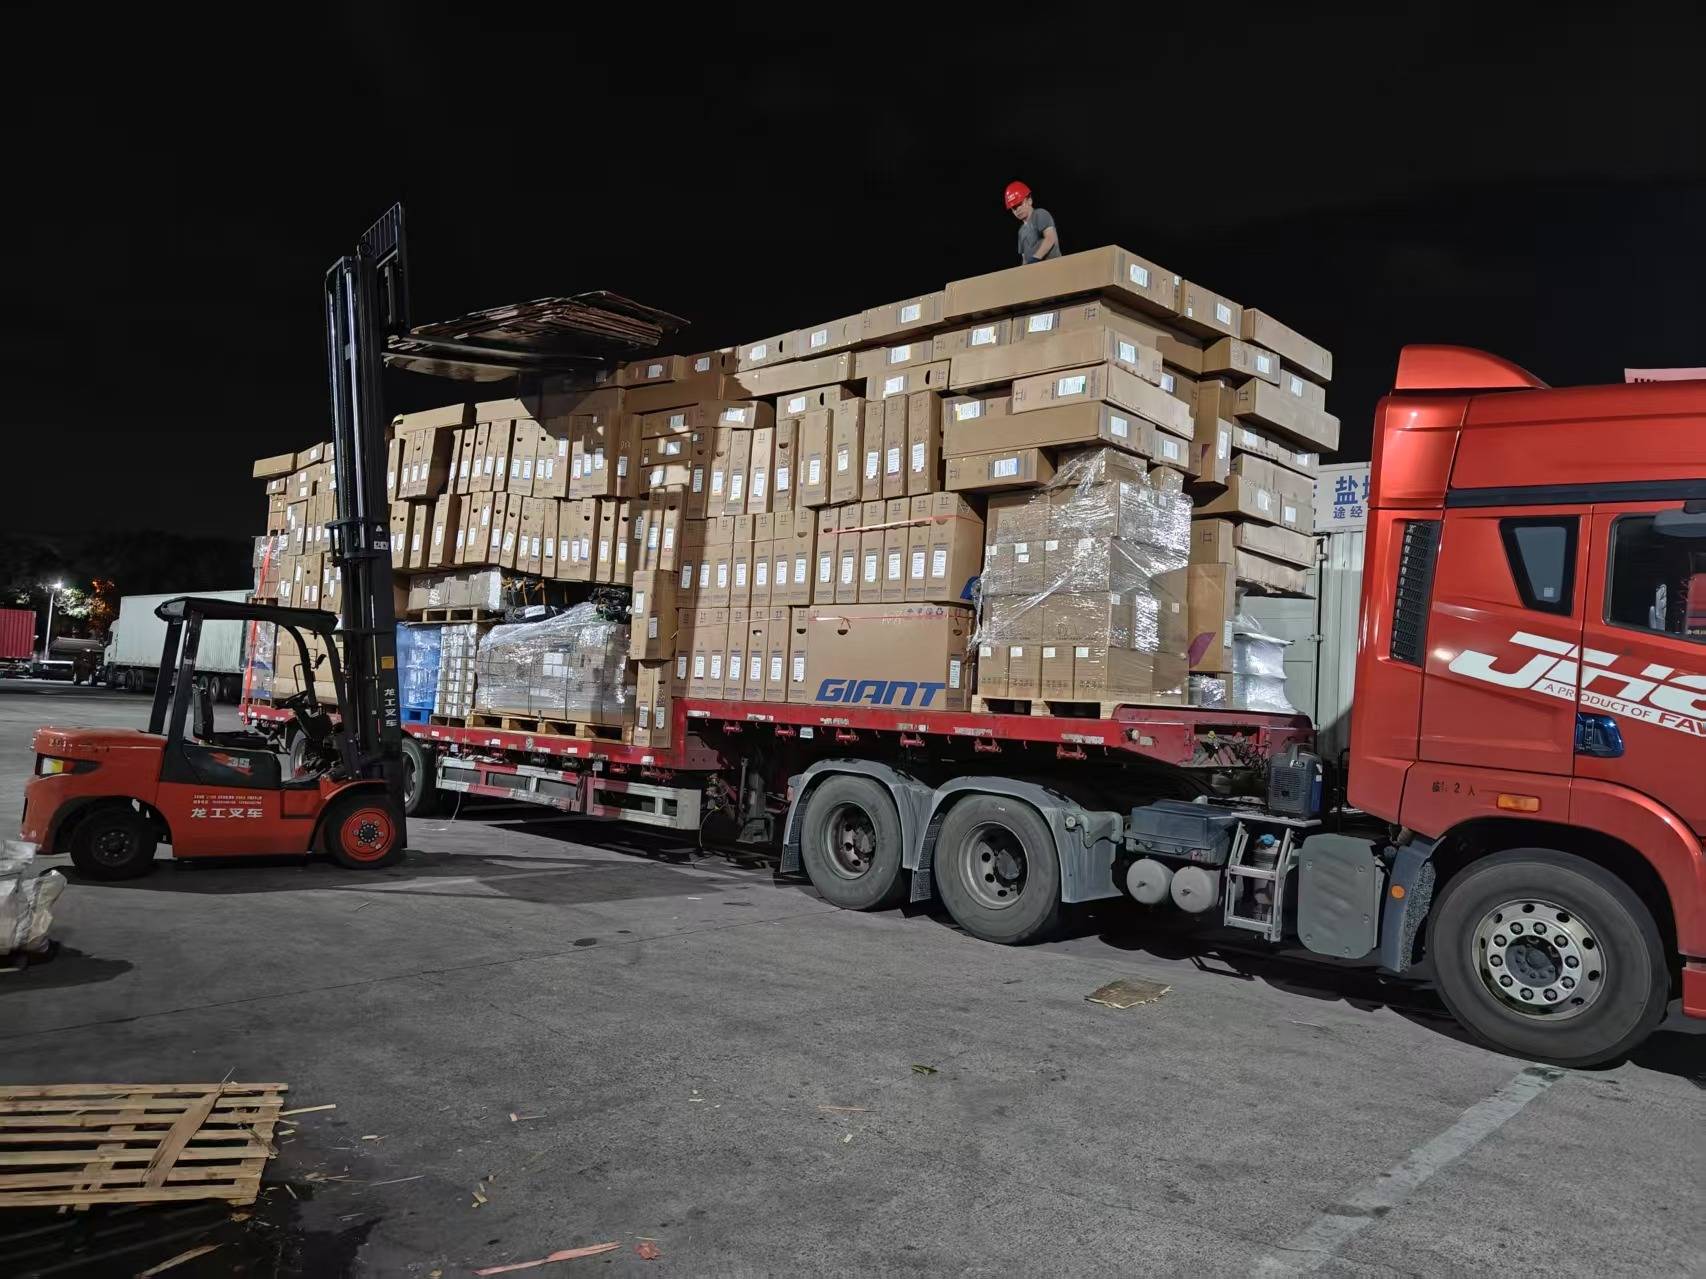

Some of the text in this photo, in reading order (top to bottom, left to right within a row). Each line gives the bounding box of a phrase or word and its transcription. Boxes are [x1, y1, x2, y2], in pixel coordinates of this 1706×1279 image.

[384, 688, 397, 727] 龙工叉车
[815, 678, 946, 706] GIANT
[1544, 683, 1554, 693] A
[1557, 686, 1629, 713] PRODUCT
[1630, 706, 1652, 719] OF
[190, 807, 263, 819] 龙工叉车
